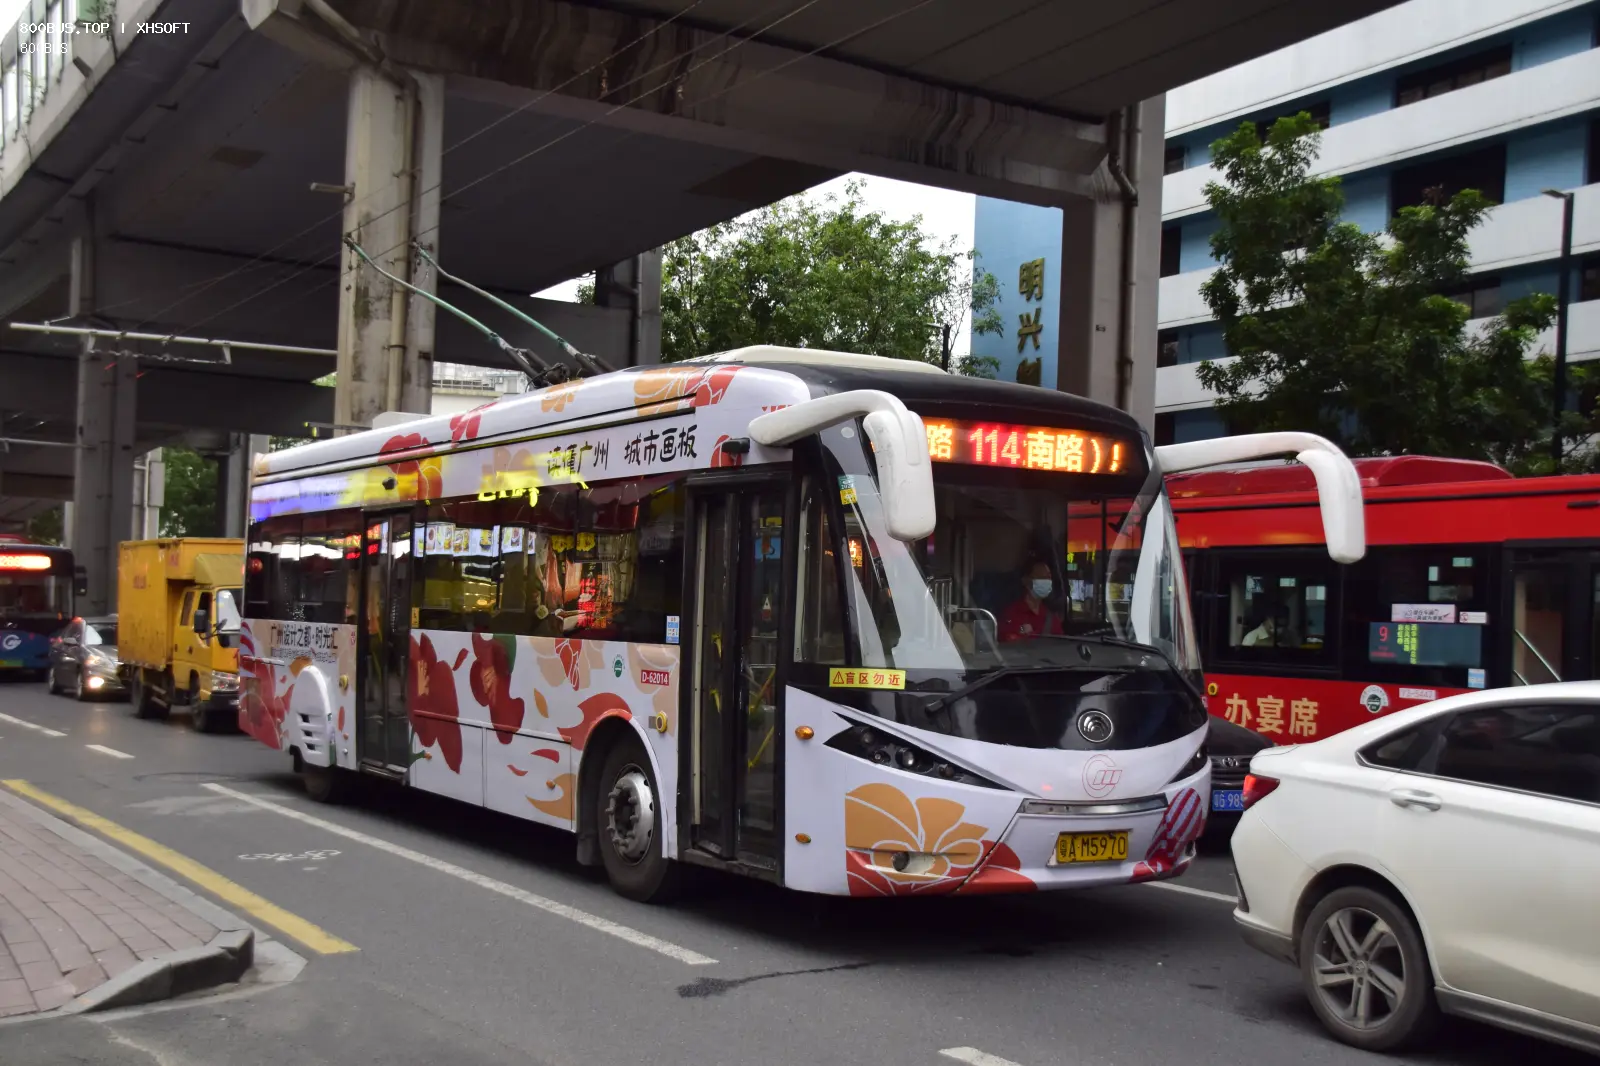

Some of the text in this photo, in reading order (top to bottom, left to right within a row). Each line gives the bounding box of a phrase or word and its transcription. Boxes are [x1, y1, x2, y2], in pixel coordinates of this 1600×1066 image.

[624, 424, 698, 466] 城市画板
[926, 424, 953, 459] 路
[970, 428, 1020, 465] 114
[1379, 626, 1388, 641] 9
[642, 671, 668, 685] D-62014
[845, 672, 901, 686] 盲区勿近
[1224, 693, 1319, 737] 办宴席
